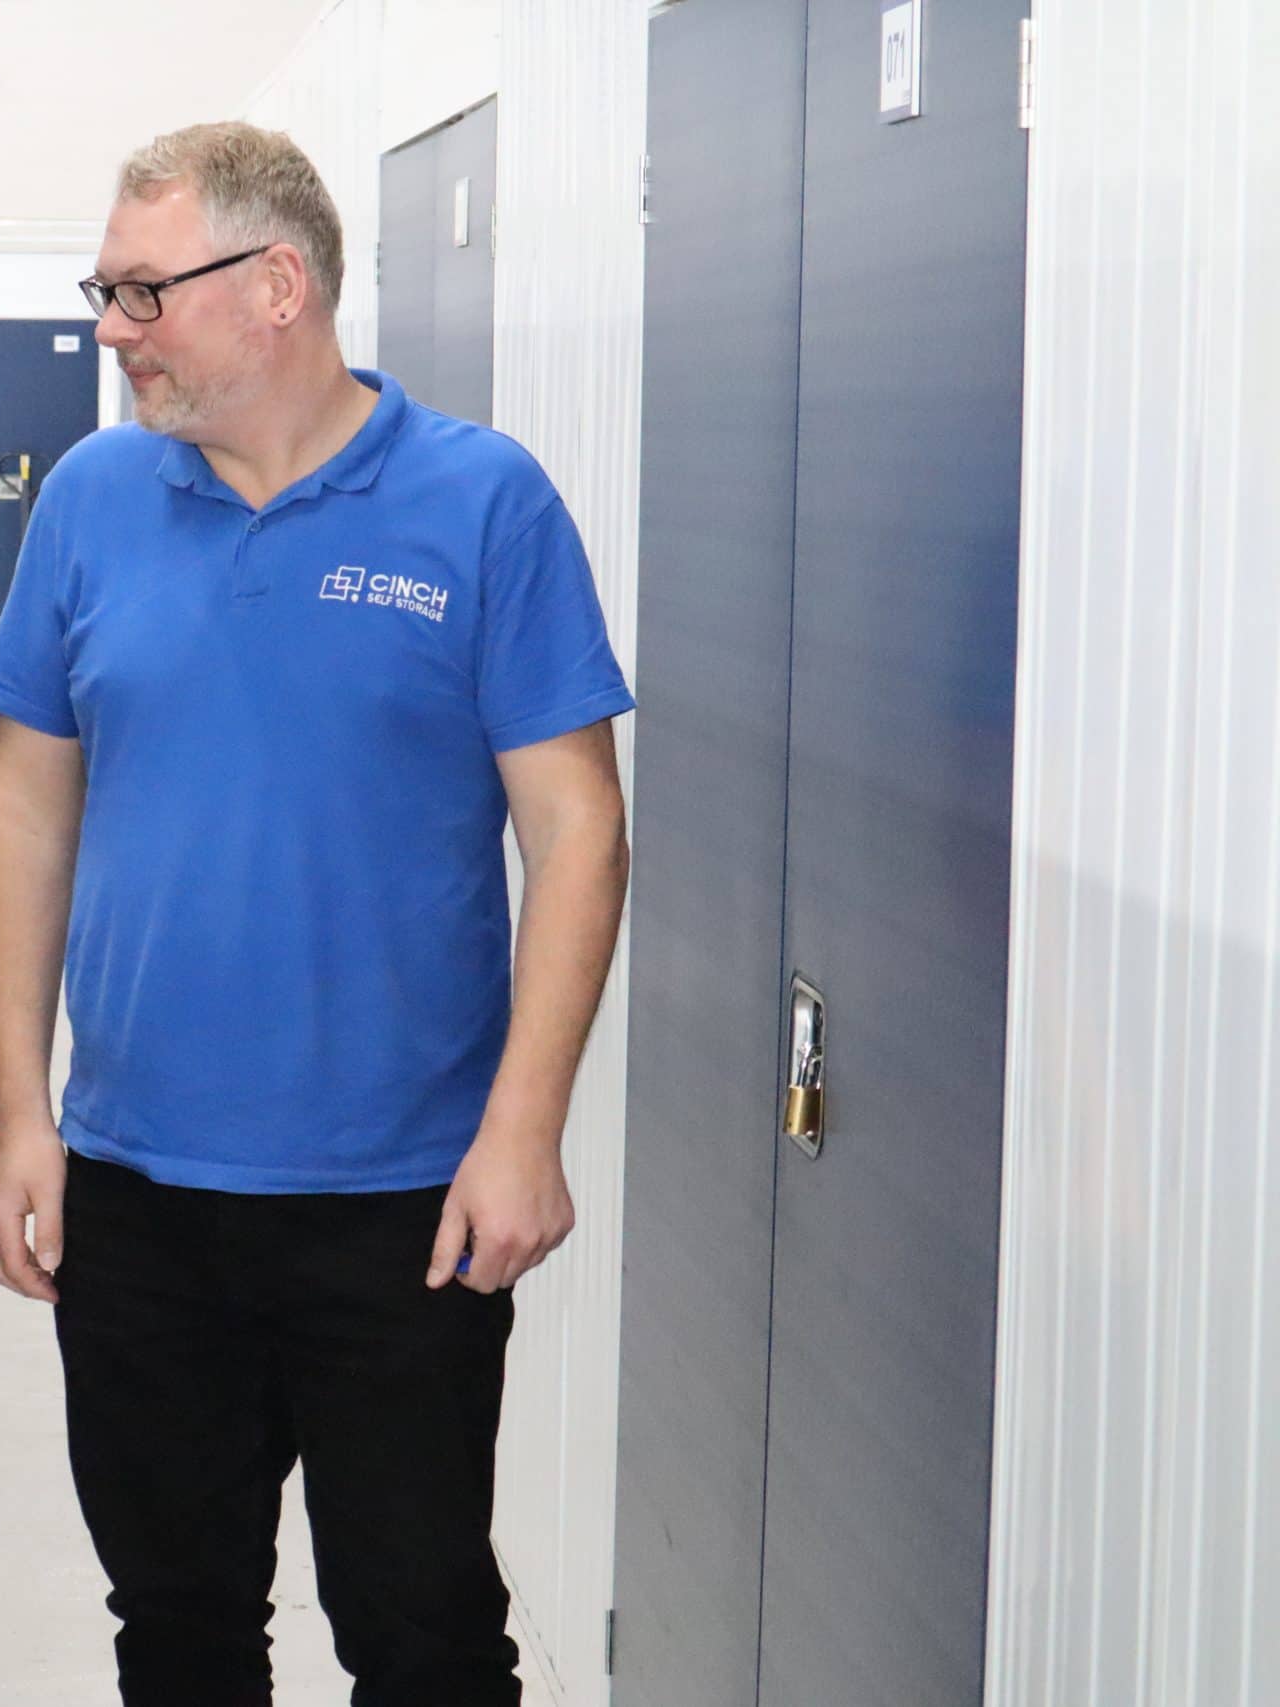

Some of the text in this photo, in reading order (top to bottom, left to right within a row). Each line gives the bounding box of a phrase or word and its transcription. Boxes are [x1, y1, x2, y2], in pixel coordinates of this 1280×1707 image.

[887, 31, 905, 83] 071
[367, 593, 444, 622] SELF STORAGE
[370, 574, 448, 611] CINCH
